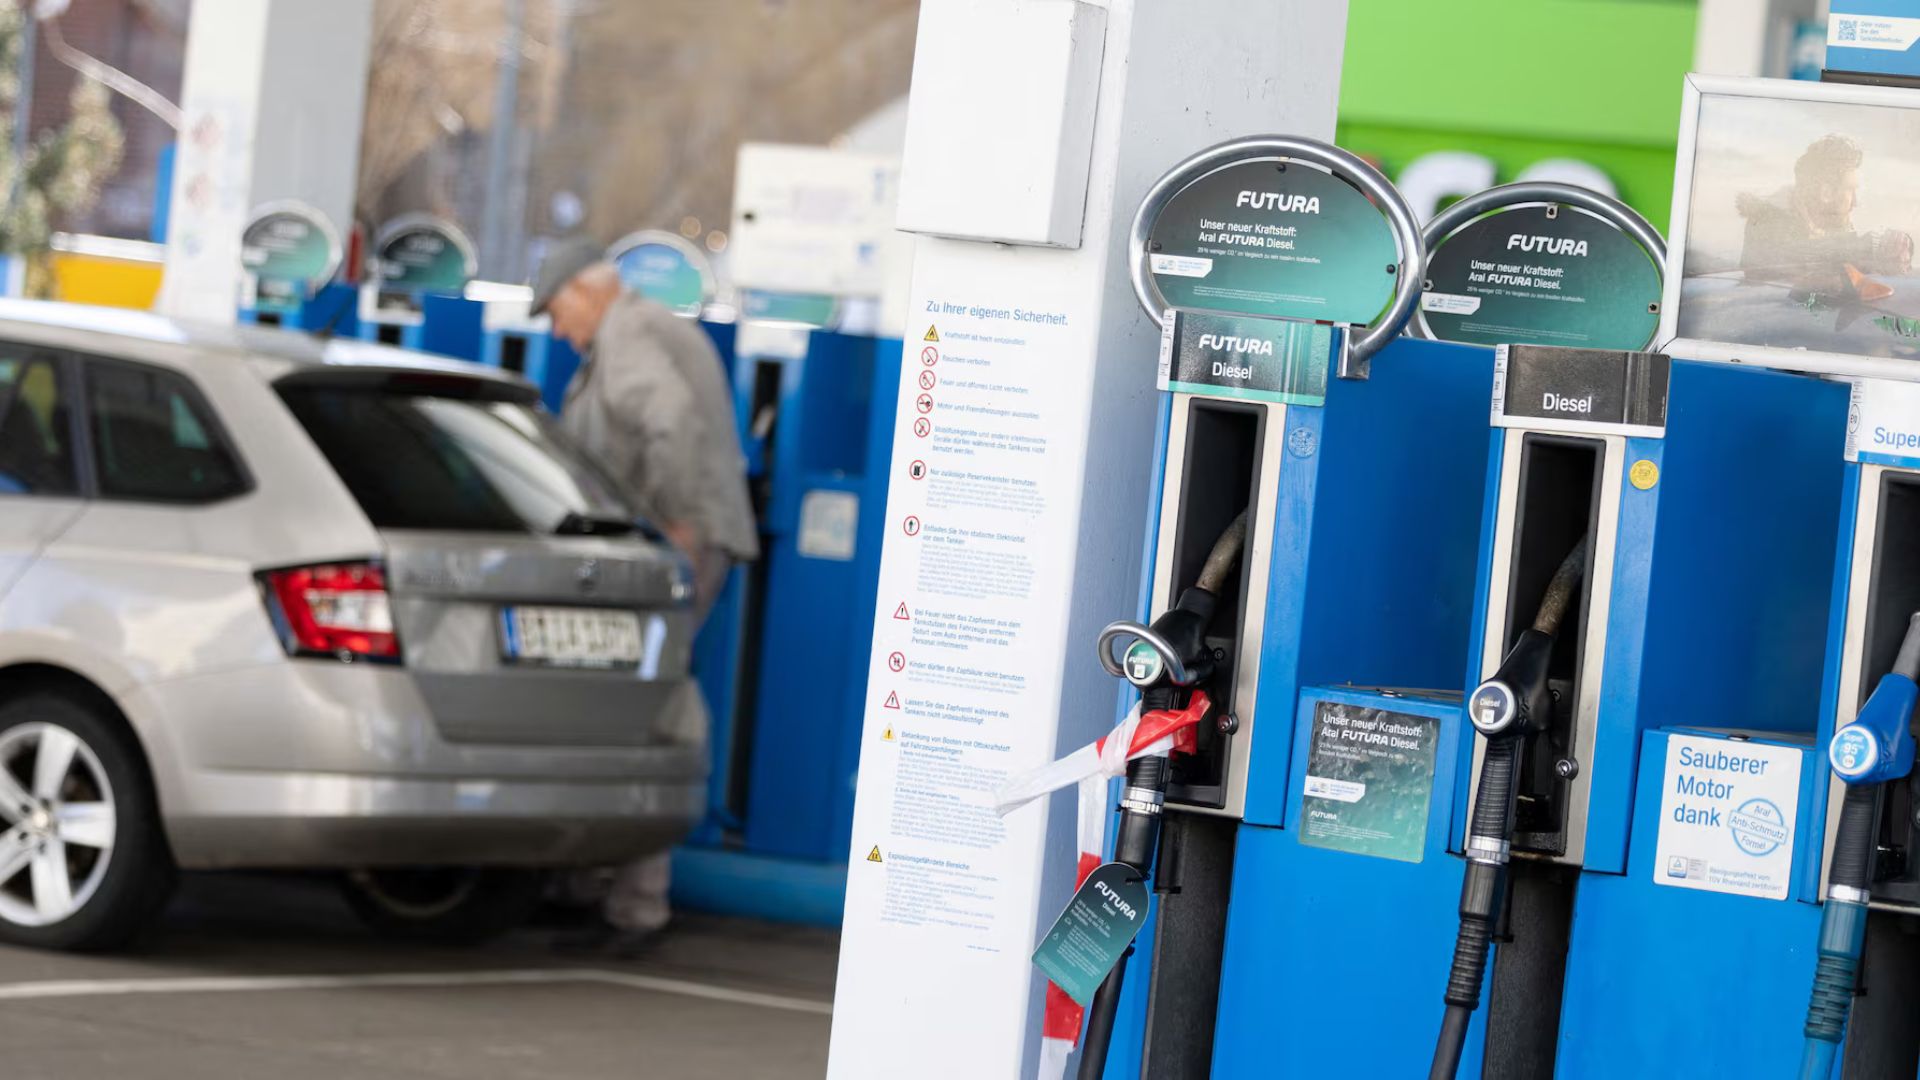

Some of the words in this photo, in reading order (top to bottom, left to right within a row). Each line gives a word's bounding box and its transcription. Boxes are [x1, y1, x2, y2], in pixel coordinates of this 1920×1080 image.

[1236, 191, 1320, 214] FUTURA
[1200, 219, 1226, 231] Unser
[1227, 222, 1252, 234] neuer
[1255, 222, 1297, 237] Kraftstoff:
[1199, 232, 1216, 243] Aral
[1218, 233, 1264, 247] FUTURA
[1266, 238, 1295, 250] Diesel.
[1507, 234, 1588, 256] FUTURA
[1471, 260, 1496, 272] Unser
[1497, 263, 1521, 274] neuer
[1523, 263, 1564, 278] Kraftstoff:
[1468, 272, 1486, 283] Aral
[1487, 274, 1532, 287] FUTURA
[1533, 278, 1562, 290] Diesel.
[926, 300, 940, 313] Zu
[943, 302, 967, 316] Ihrer
[970, 306, 1010, 320] eigenen
[1014, 309, 1068, 325] Sicherheit.
[1199, 334, 1273, 356] FUTURA
[1212, 362, 1252, 380] Diesel
[1543, 392, 1592, 413] Diesel
[914, 608, 924, 616] Bei
[925, 609, 941, 618] Feuer
[942, 611, 955, 620] nicht
[957, 614, 967, 622] das
[968, 615, 996, 626] Zapfventil
[914, 617, 946, 629] Tankstutzen
[947, 622, 958, 630] des
[959, 624, 988, 635] Fahrzeugs
[912, 636, 936, 646] Personal
[913, 627, 930, 636] Sofort
[944, 631, 957, 640] Auto
[986, 637, 997, 645] und
[998, 639, 1009, 647] das
[909, 661, 926, 670] Kinder
[928, 663, 945, 672] dürfen
[957, 667, 983, 678] Zapfsäule
[984, 670, 999, 679] nicht
[904, 698, 925, 707] Lassen
[925, 700, 934, 708] Sie
[946, 703, 973, 714] Zapfventil
[974, 708, 999, 717] während
[904, 707, 926, 718] Tankens
[1323, 713, 1349, 726] Unser
[1351, 718, 1377, 730] neuer
[1379, 721, 1422, 737] Kraftstoff:
[901, 731, 930, 743] Betankung
[943, 736, 962, 746] Booten
[963, 739, 972, 747] mit
[1321, 726, 1339, 738] Aral
[1341, 730, 1388, 746] FUTURA
[1391, 736, 1420, 750] Diesel.
[1679, 747, 1768, 775] Sauberer
[1677, 774, 1734, 800] Motor
[1310, 811, 1337, 820] FUTURA
[1674, 804, 1721, 827] dank
[1754, 805, 1771, 817] Aral
[1731, 816, 1784, 840] Anti-Schmutz
[1741, 835, 1766, 849] Formel
[946, 860, 970, 871] Bereiche
[1094, 881, 1137, 921] FUTURA
